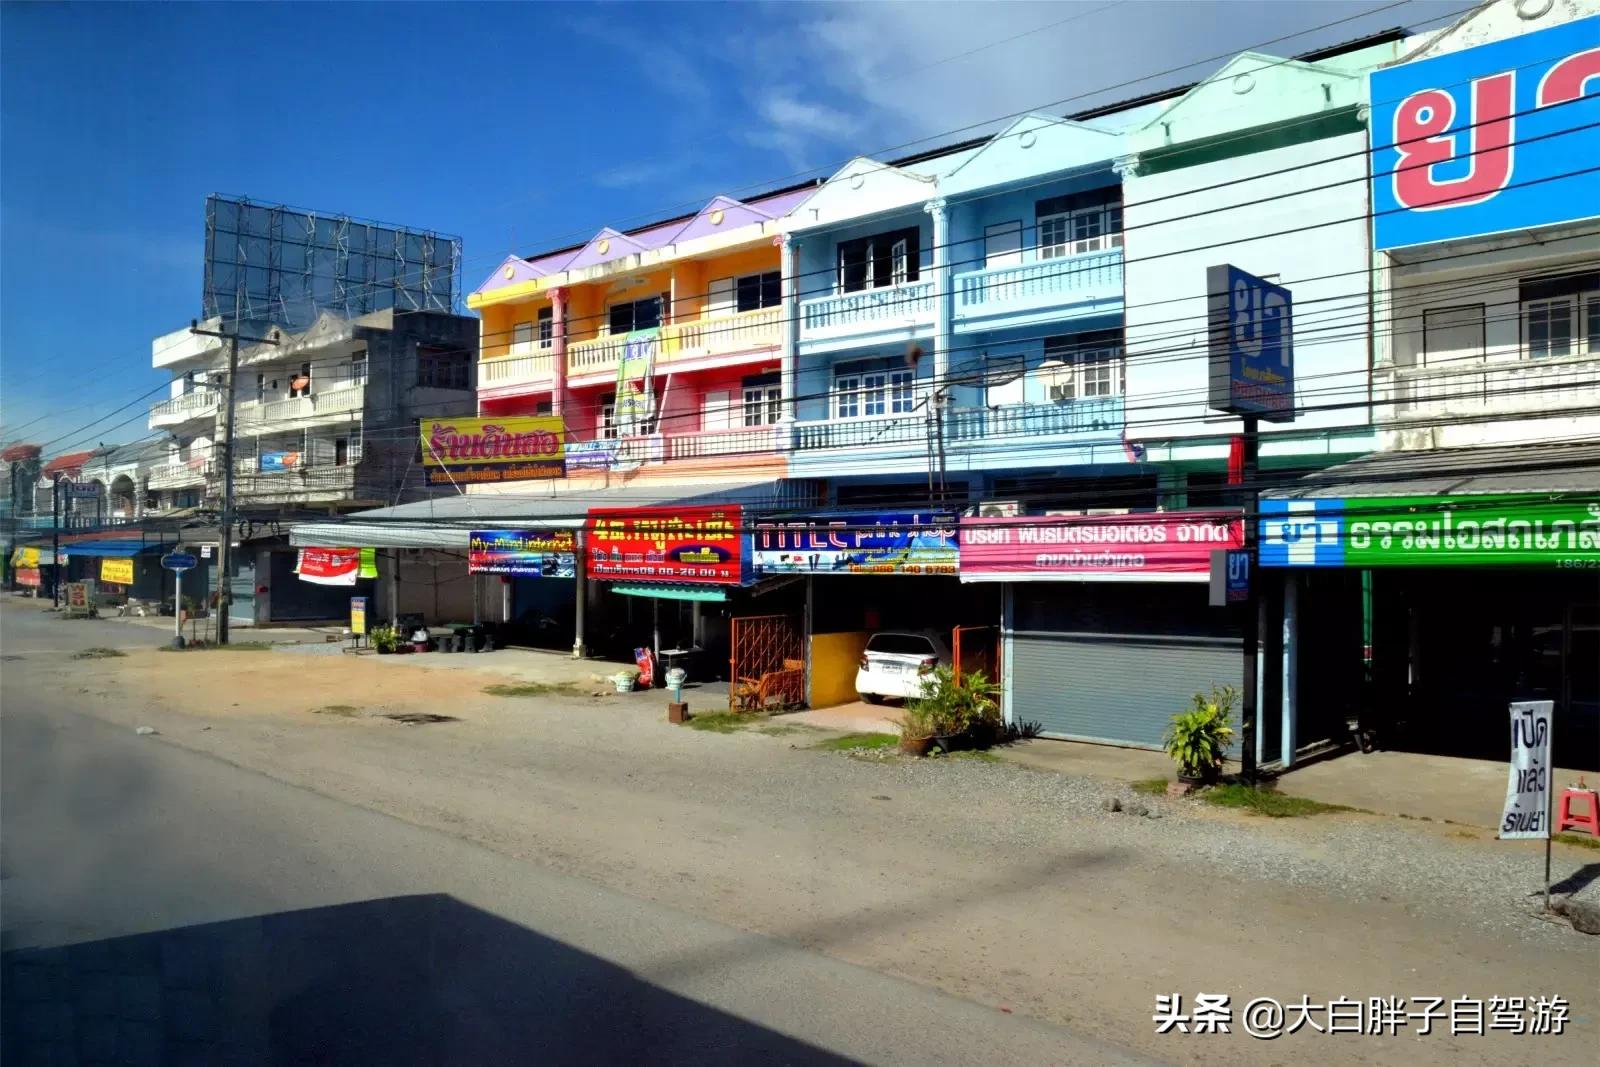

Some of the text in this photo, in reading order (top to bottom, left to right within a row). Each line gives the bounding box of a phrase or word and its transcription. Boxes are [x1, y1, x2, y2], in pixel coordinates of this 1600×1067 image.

[1235, 279, 1289, 368] ยา
[757, 522, 848, 548] TITLE
[965, 525, 1010, 544] บรษท
[1018, 522, 1167, 543] พนธมตรมอเตอร
[1281, 523, 1322, 543] ยา
[1229, 553, 1249, 580] ยา
[1513, 709, 1548, 749] เปิด
[1516, 758, 1546, 794] แล้ว
[1503, 802, 1545, 833] ร้านยา
